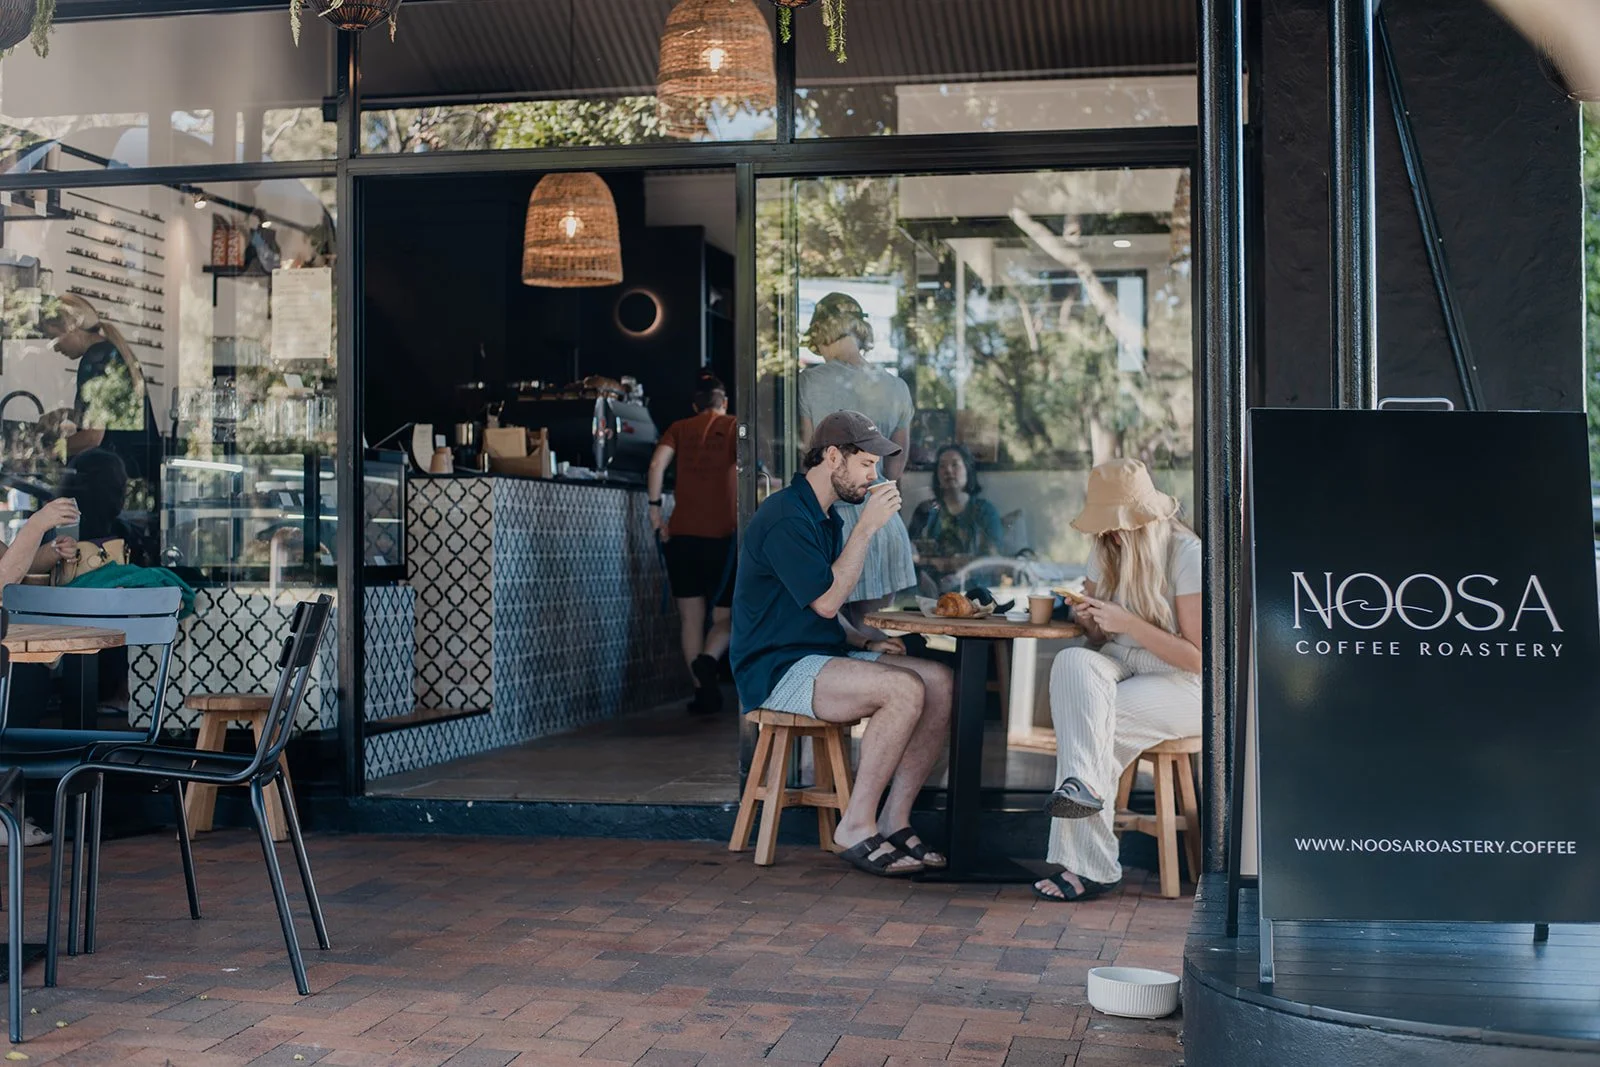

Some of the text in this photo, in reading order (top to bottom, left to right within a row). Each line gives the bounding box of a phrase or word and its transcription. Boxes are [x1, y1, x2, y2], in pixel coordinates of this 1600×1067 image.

[1291, 571, 1564, 633] NOOSA
[1295, 640, 1564, 658] COFFEE ROASTERY
[1294, 837, 1577, 855] WWW.NOOSAROASTERY.COFFEE
